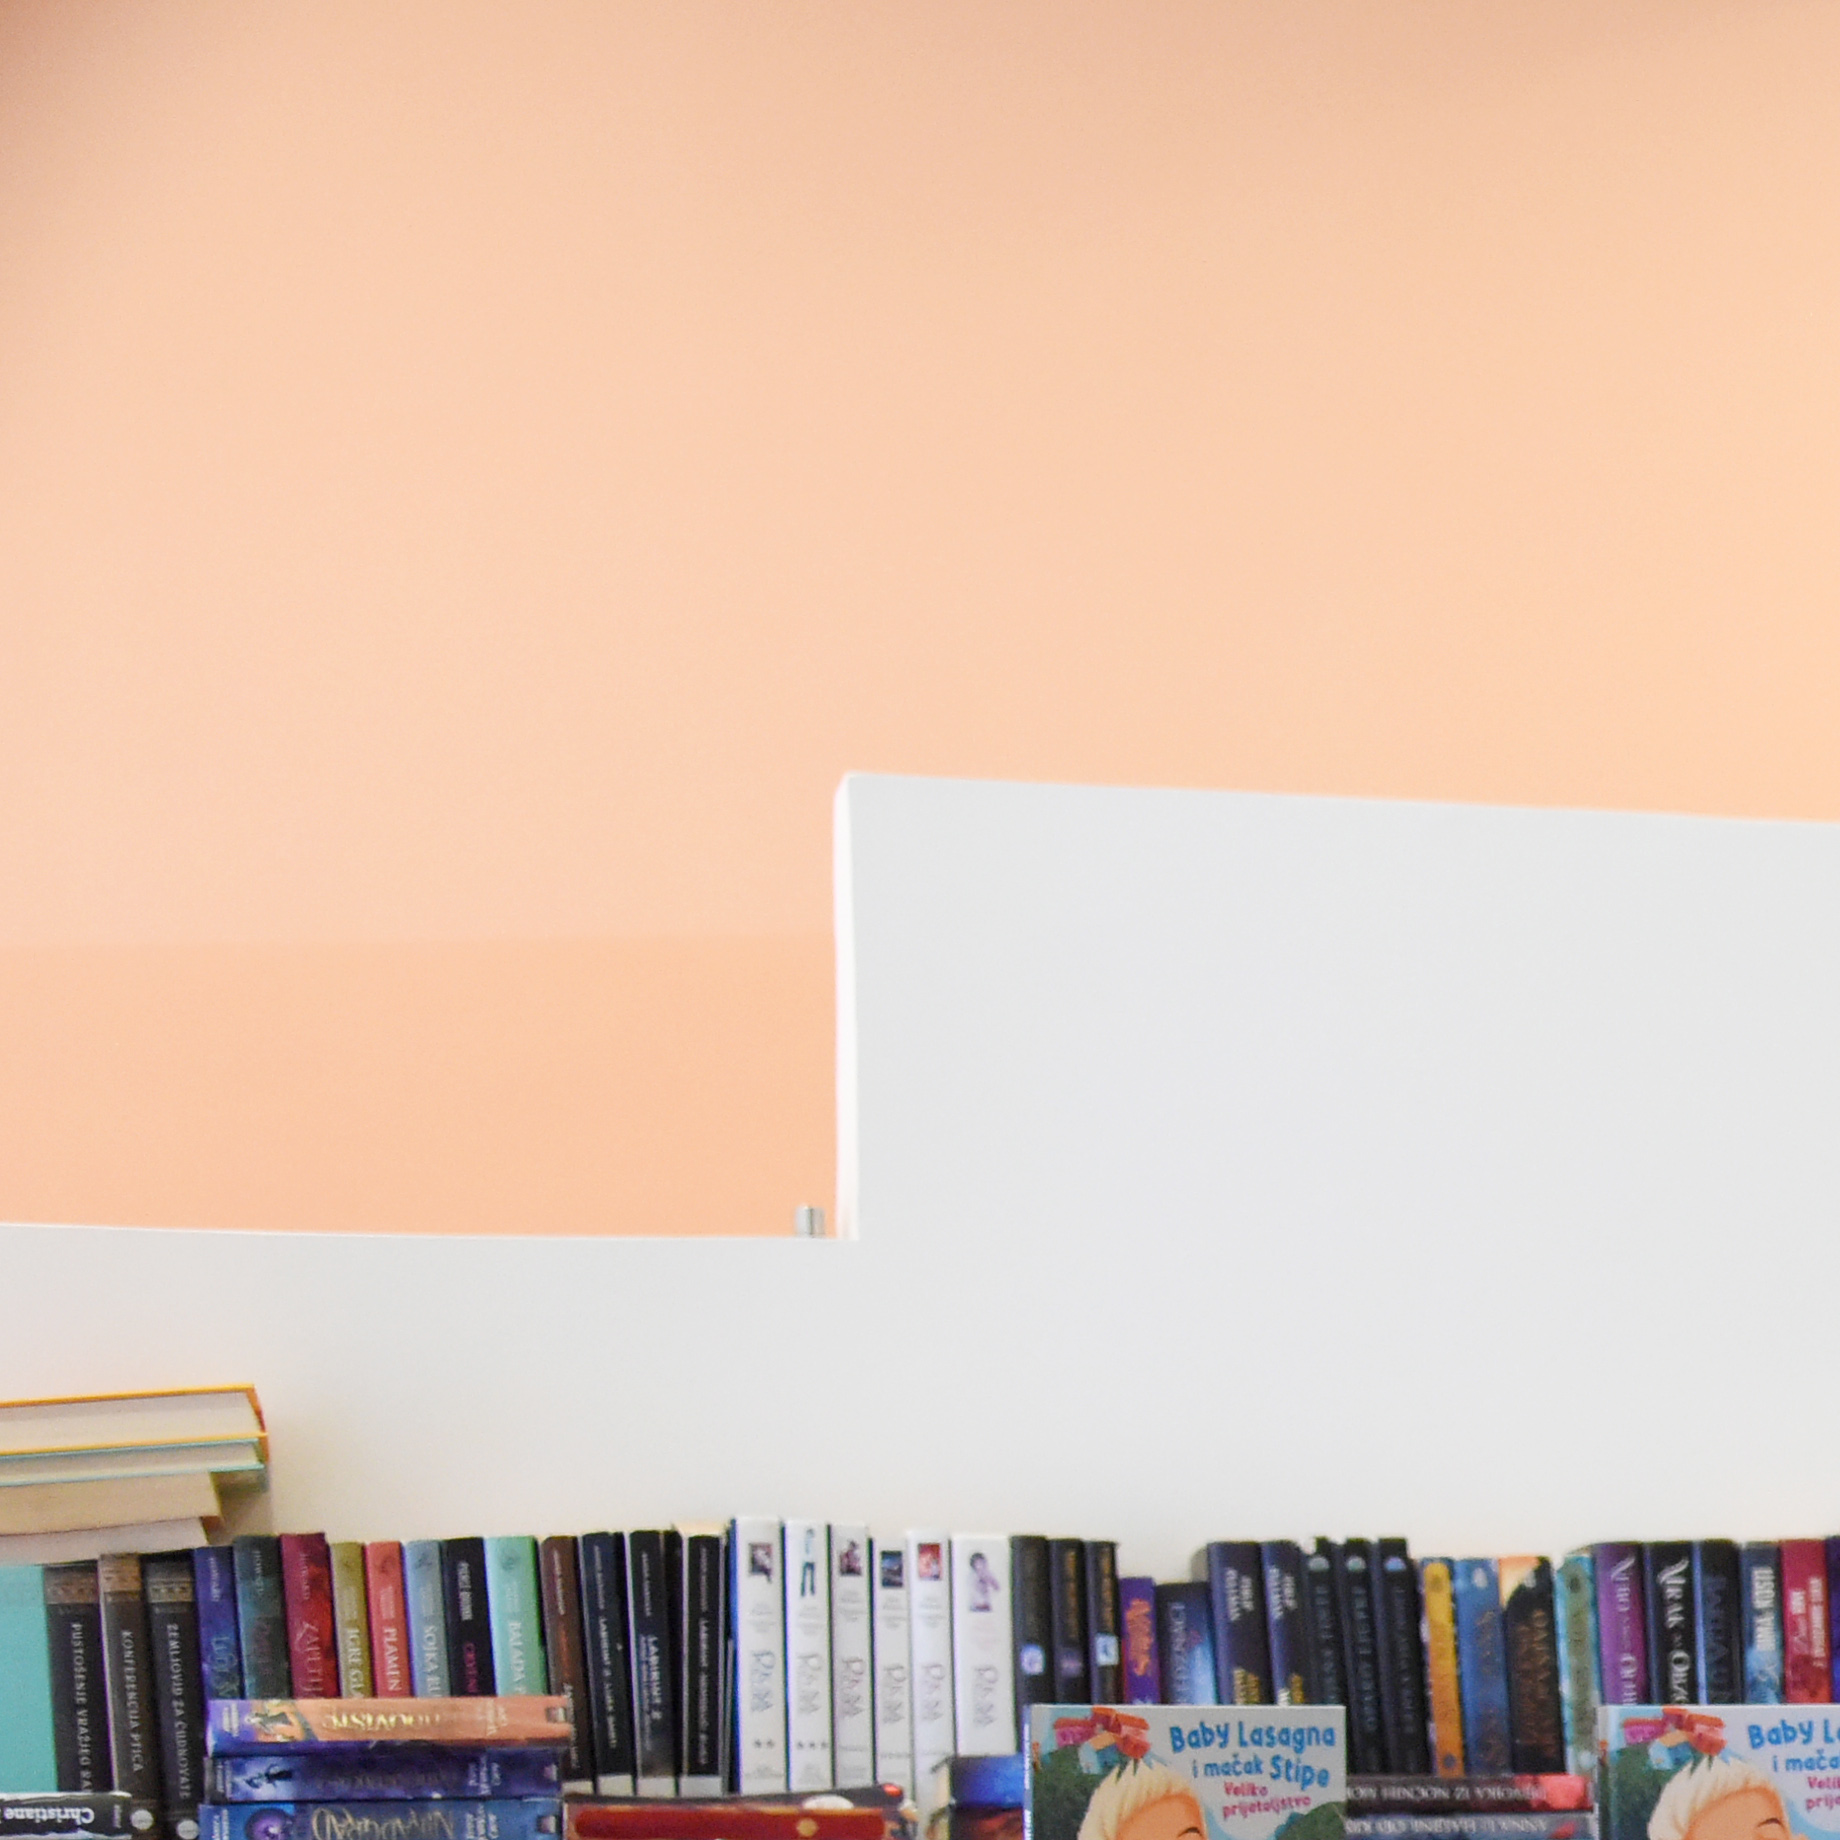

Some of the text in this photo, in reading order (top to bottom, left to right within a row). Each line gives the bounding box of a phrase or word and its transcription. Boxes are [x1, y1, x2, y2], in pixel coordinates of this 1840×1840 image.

[383, 1627, 401, 1691] PLAMEN
[508, 1621, 526, 1681] BALADA
[121, 1630, 145, 1771] KONFERENCIJA PTICA
[166, 1623, 192, 1798] ZEMLJOVID ZA ČUDNOVATE
[1169, 1720, 1336, 1755] Baby Lasagna
[1748, 1719, 1814, 1750] Baby
[1204, 1752, 1264, 1777] mačak
[1269, 1754, 1330, 1791] Stipe
[1223, 1781, 1269, 1797] Veliko
[3, 1807, 95, 1826] Christiane
[1222, 1796, 1312, 1819] prijateljstvo
[1377, 1819, 1408, 1834] OD
[1498, 1818, 1548, 1832] ANNA
